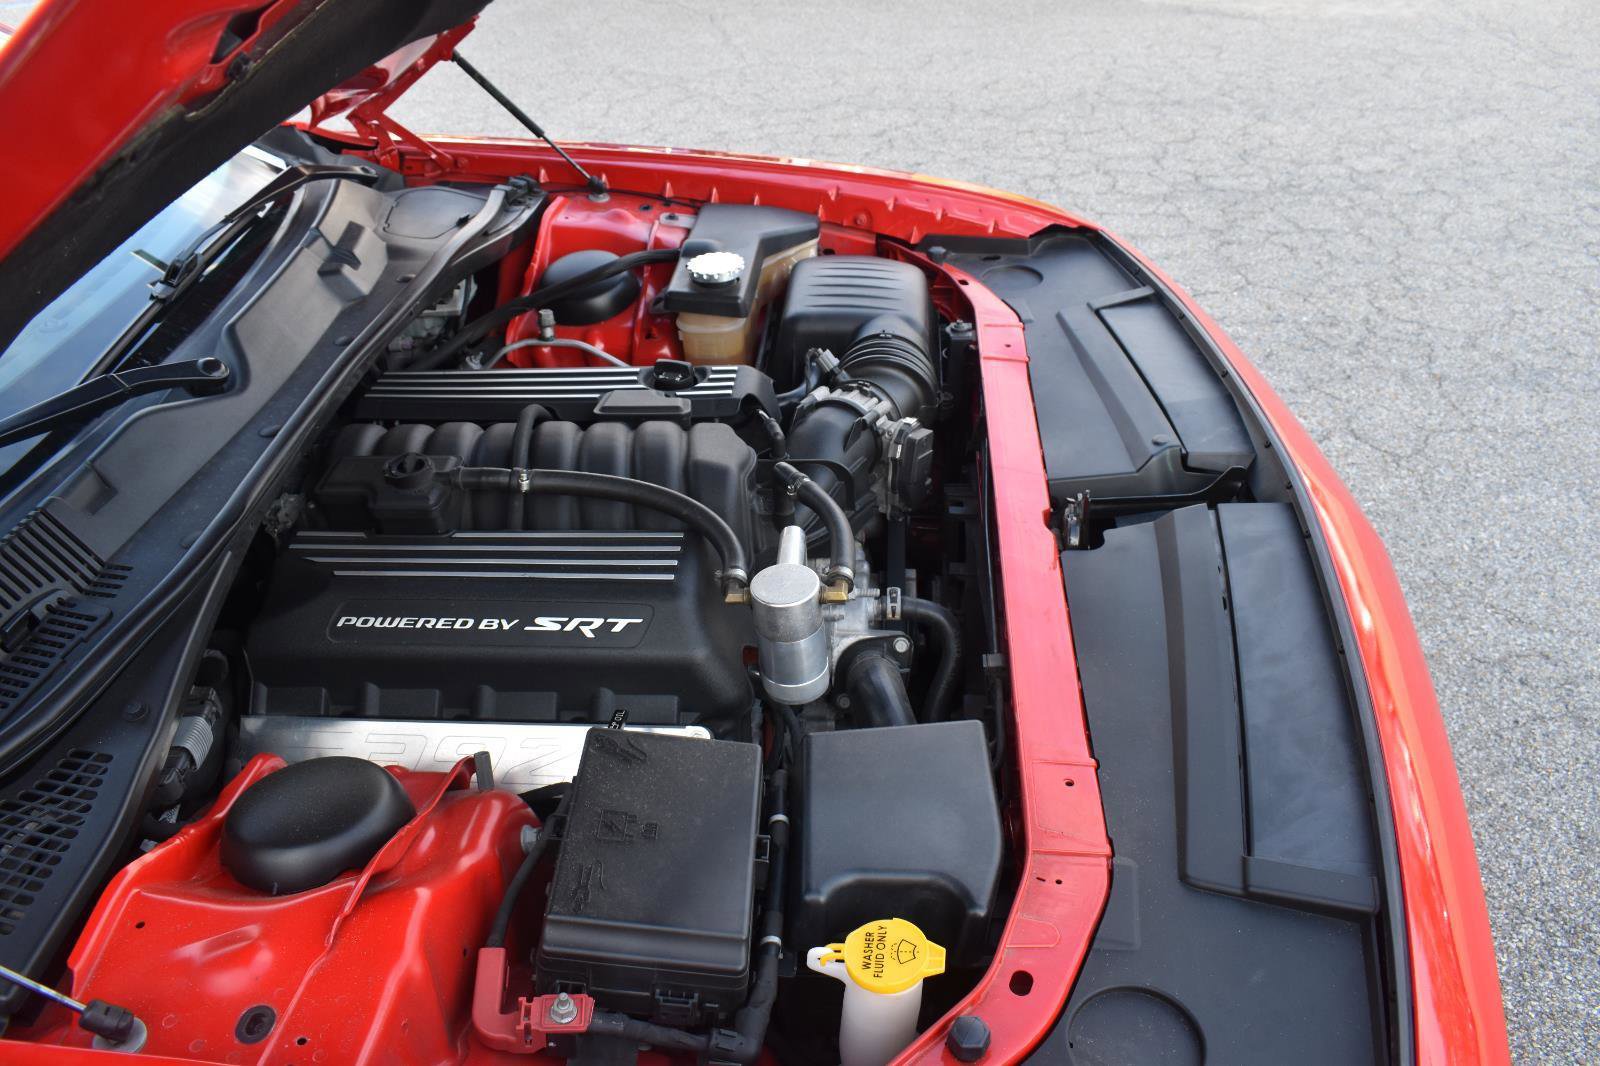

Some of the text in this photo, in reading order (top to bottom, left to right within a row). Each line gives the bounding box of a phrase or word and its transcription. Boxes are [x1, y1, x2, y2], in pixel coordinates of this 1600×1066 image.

[336, 616, 644, 638] POWERED BY SRT
[862, 931, 875, 970] WASHER
[873, 925, 888, 978] FLUID ONLY
